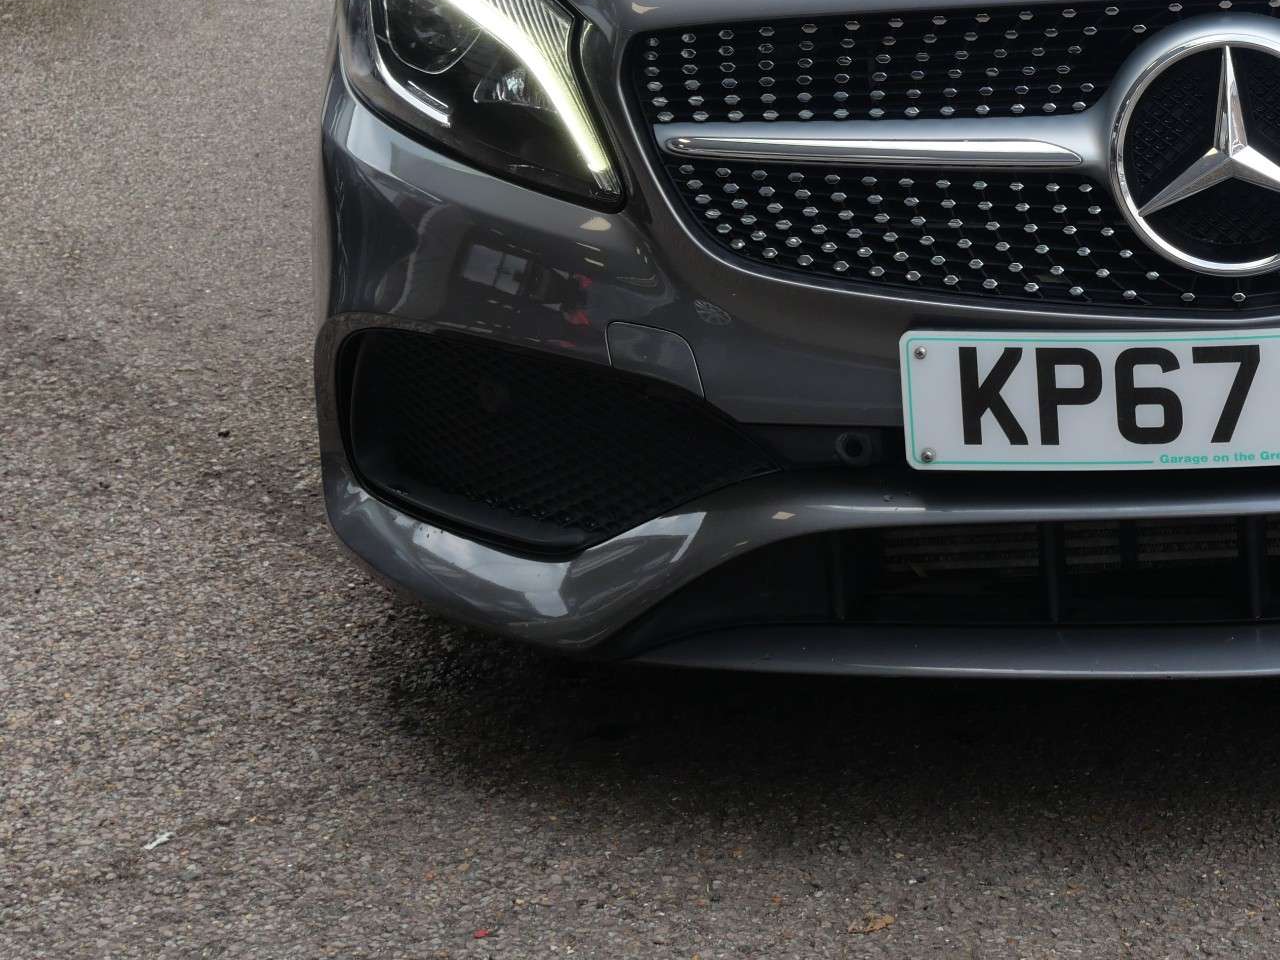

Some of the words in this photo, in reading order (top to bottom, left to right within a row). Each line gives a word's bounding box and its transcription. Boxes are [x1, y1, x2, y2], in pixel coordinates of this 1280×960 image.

[958, 346, 1261, 446] KP67
[1160, 454, 1209, 465] Garage
[1213, 454, 1230, 462] on
[1234, 452, 1255, 462] the
